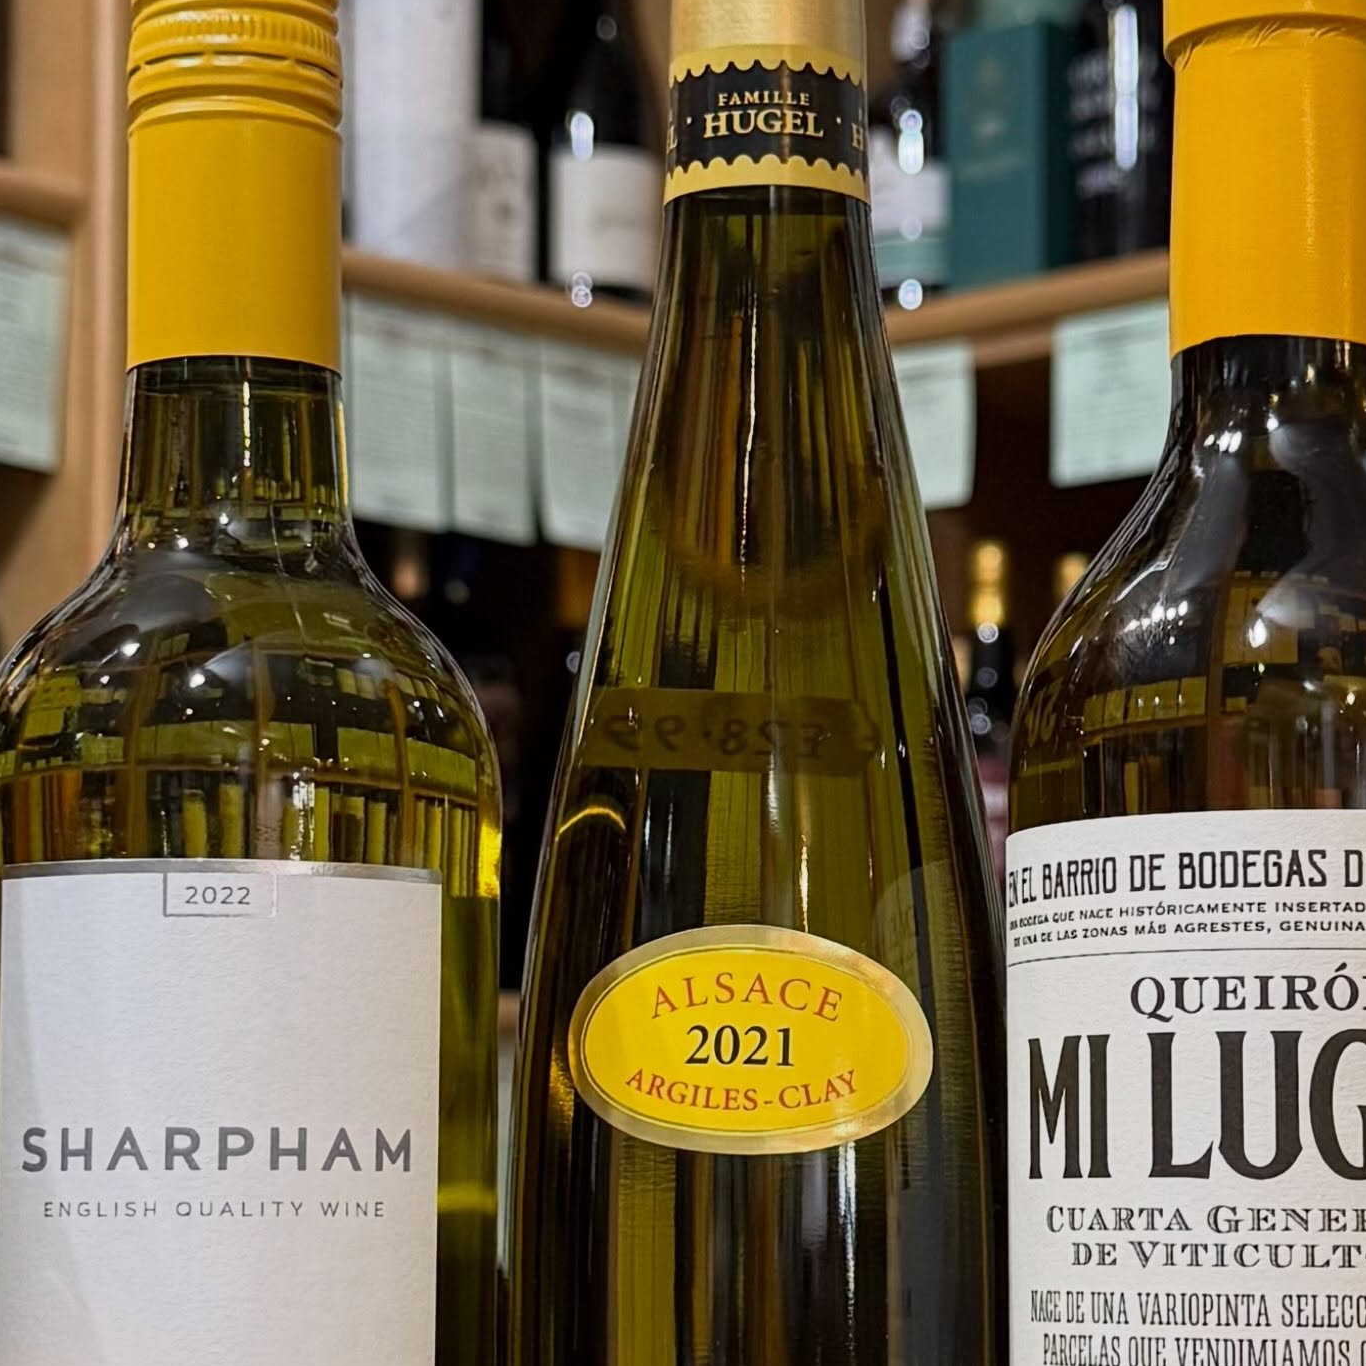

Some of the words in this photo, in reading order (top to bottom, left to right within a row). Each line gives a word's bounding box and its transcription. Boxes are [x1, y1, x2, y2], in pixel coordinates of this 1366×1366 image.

[718, 91, 810, 106] FAMILLE
[703, 109, 824, 138] HUGEL
[1042, 856, 1117, 900] BARRIO
[1129, 854, 1166, 892] DE
[1178, 849, 1327, 890] BODEGAS
[185, 886, 251, 906] 2022
[1080, 908, 1113, 920] NACE
[1119, 901, 1267, 917] HISTÓRICAMENTE
[1083, 926, 1127, 939] ZONAS
[1174, 921, 1271, 934] AGRESTES,
[651, 972, 842, 1022] ALSACE
[685, 1025, 794, 1067] 2021
[625, 1069, 857, 1111] ARGILES-CLAY
[1028, 1034, 1112, 1180] MI
[21, 1126, 412, 1173] SHARPHAM
[43, 1201, 158, 1218] ENGLISH
[176, 1201, 303, 1219] QUALITY
[320, 1200, 385, 1218] WINE
[1046, 1204, 1193, 1232] CUARTA
[1072, 1243, 1118, 1267] DE
[1065, 1291, 1086, 1325] DE
[1090, 1292, 1130, 1326] UNA
[1137, 1293, 1271, 1328] VARIOPINTA
